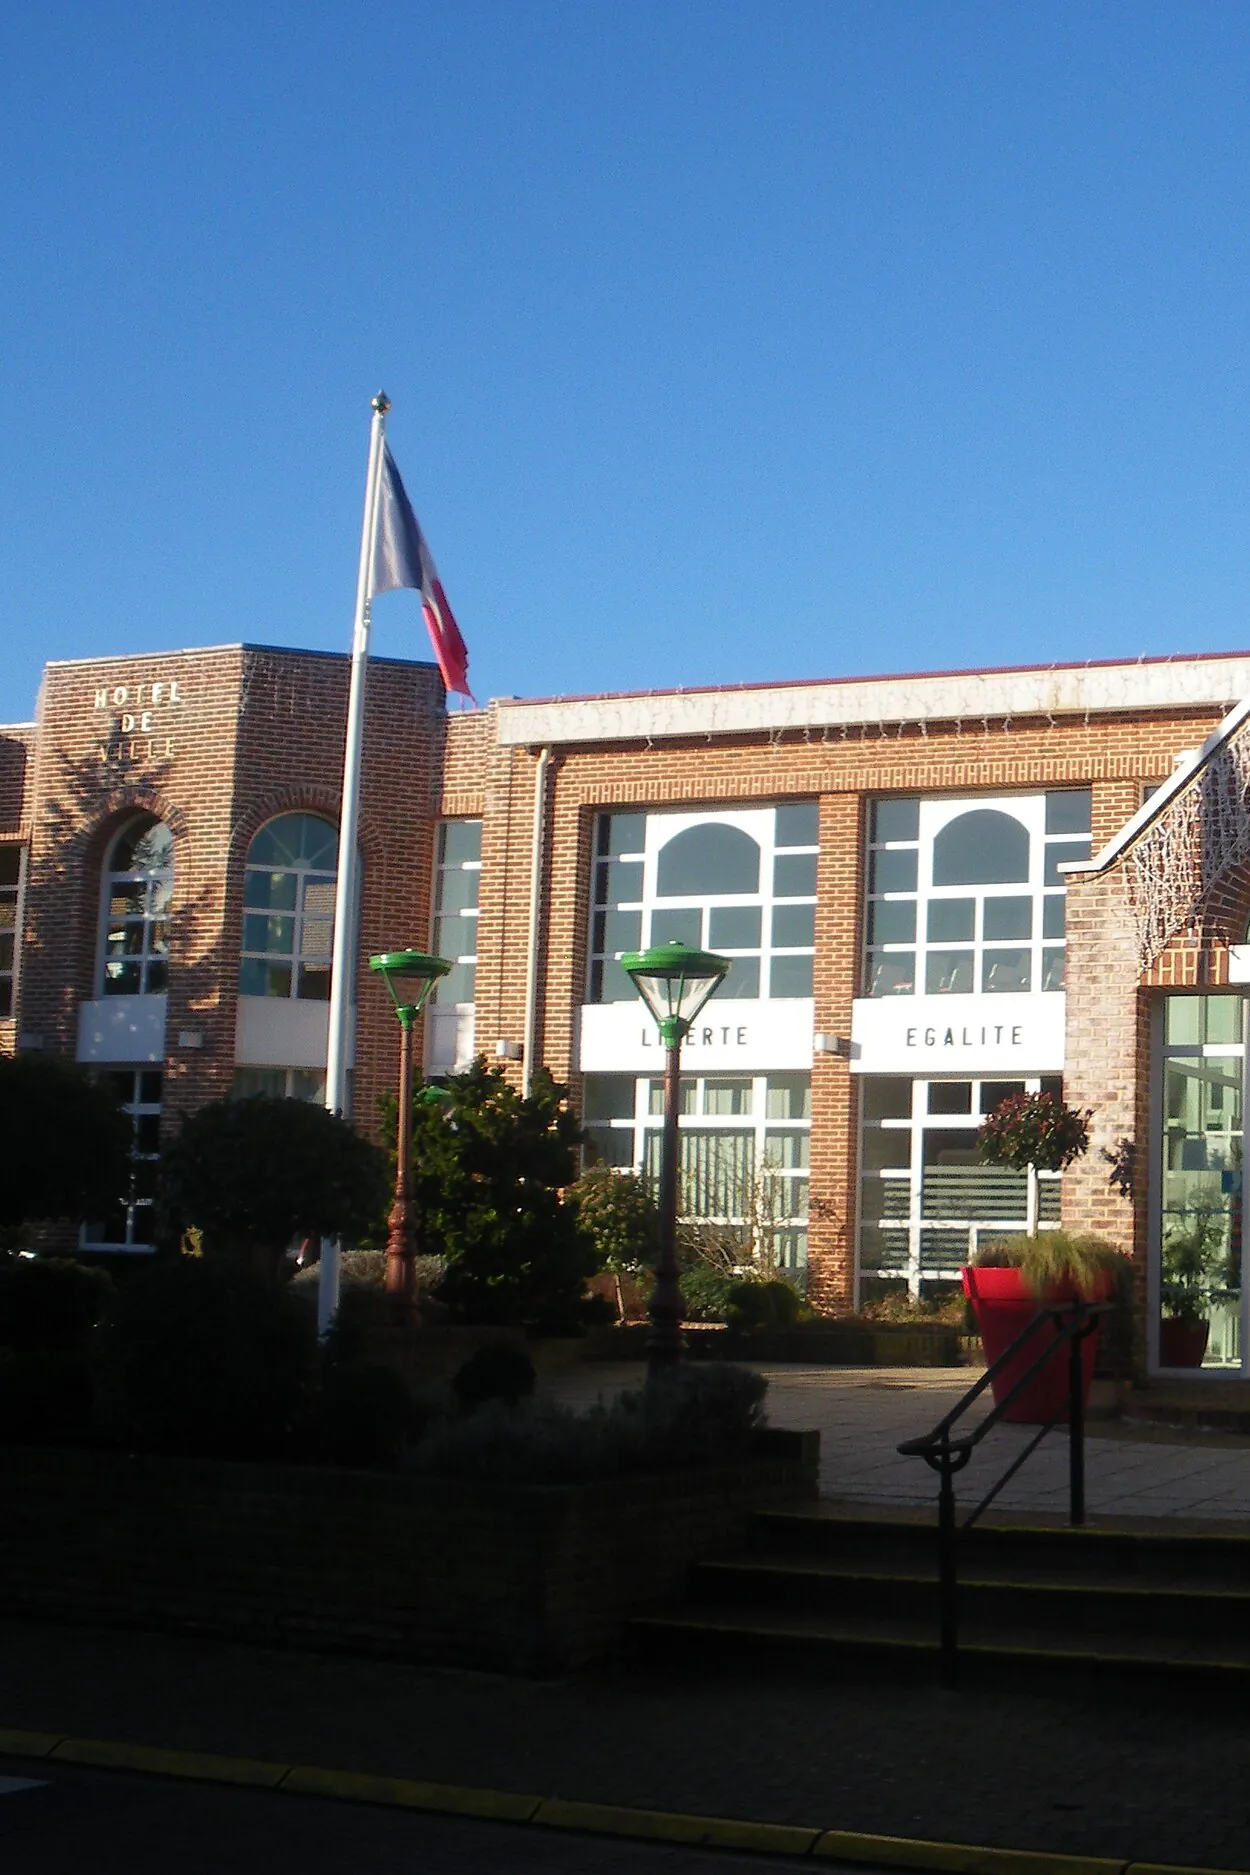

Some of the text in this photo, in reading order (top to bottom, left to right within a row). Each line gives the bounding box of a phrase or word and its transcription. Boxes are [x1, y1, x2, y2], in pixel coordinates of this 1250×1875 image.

[94, 681, 180, 708] HOTEL
[122, 712, 153, 732] DE
[100, 738, 175, 762] VILLE
[641, 1026, 747, 1046] LIERTE
[906, 1025, 1023, 1046] EGALITE
